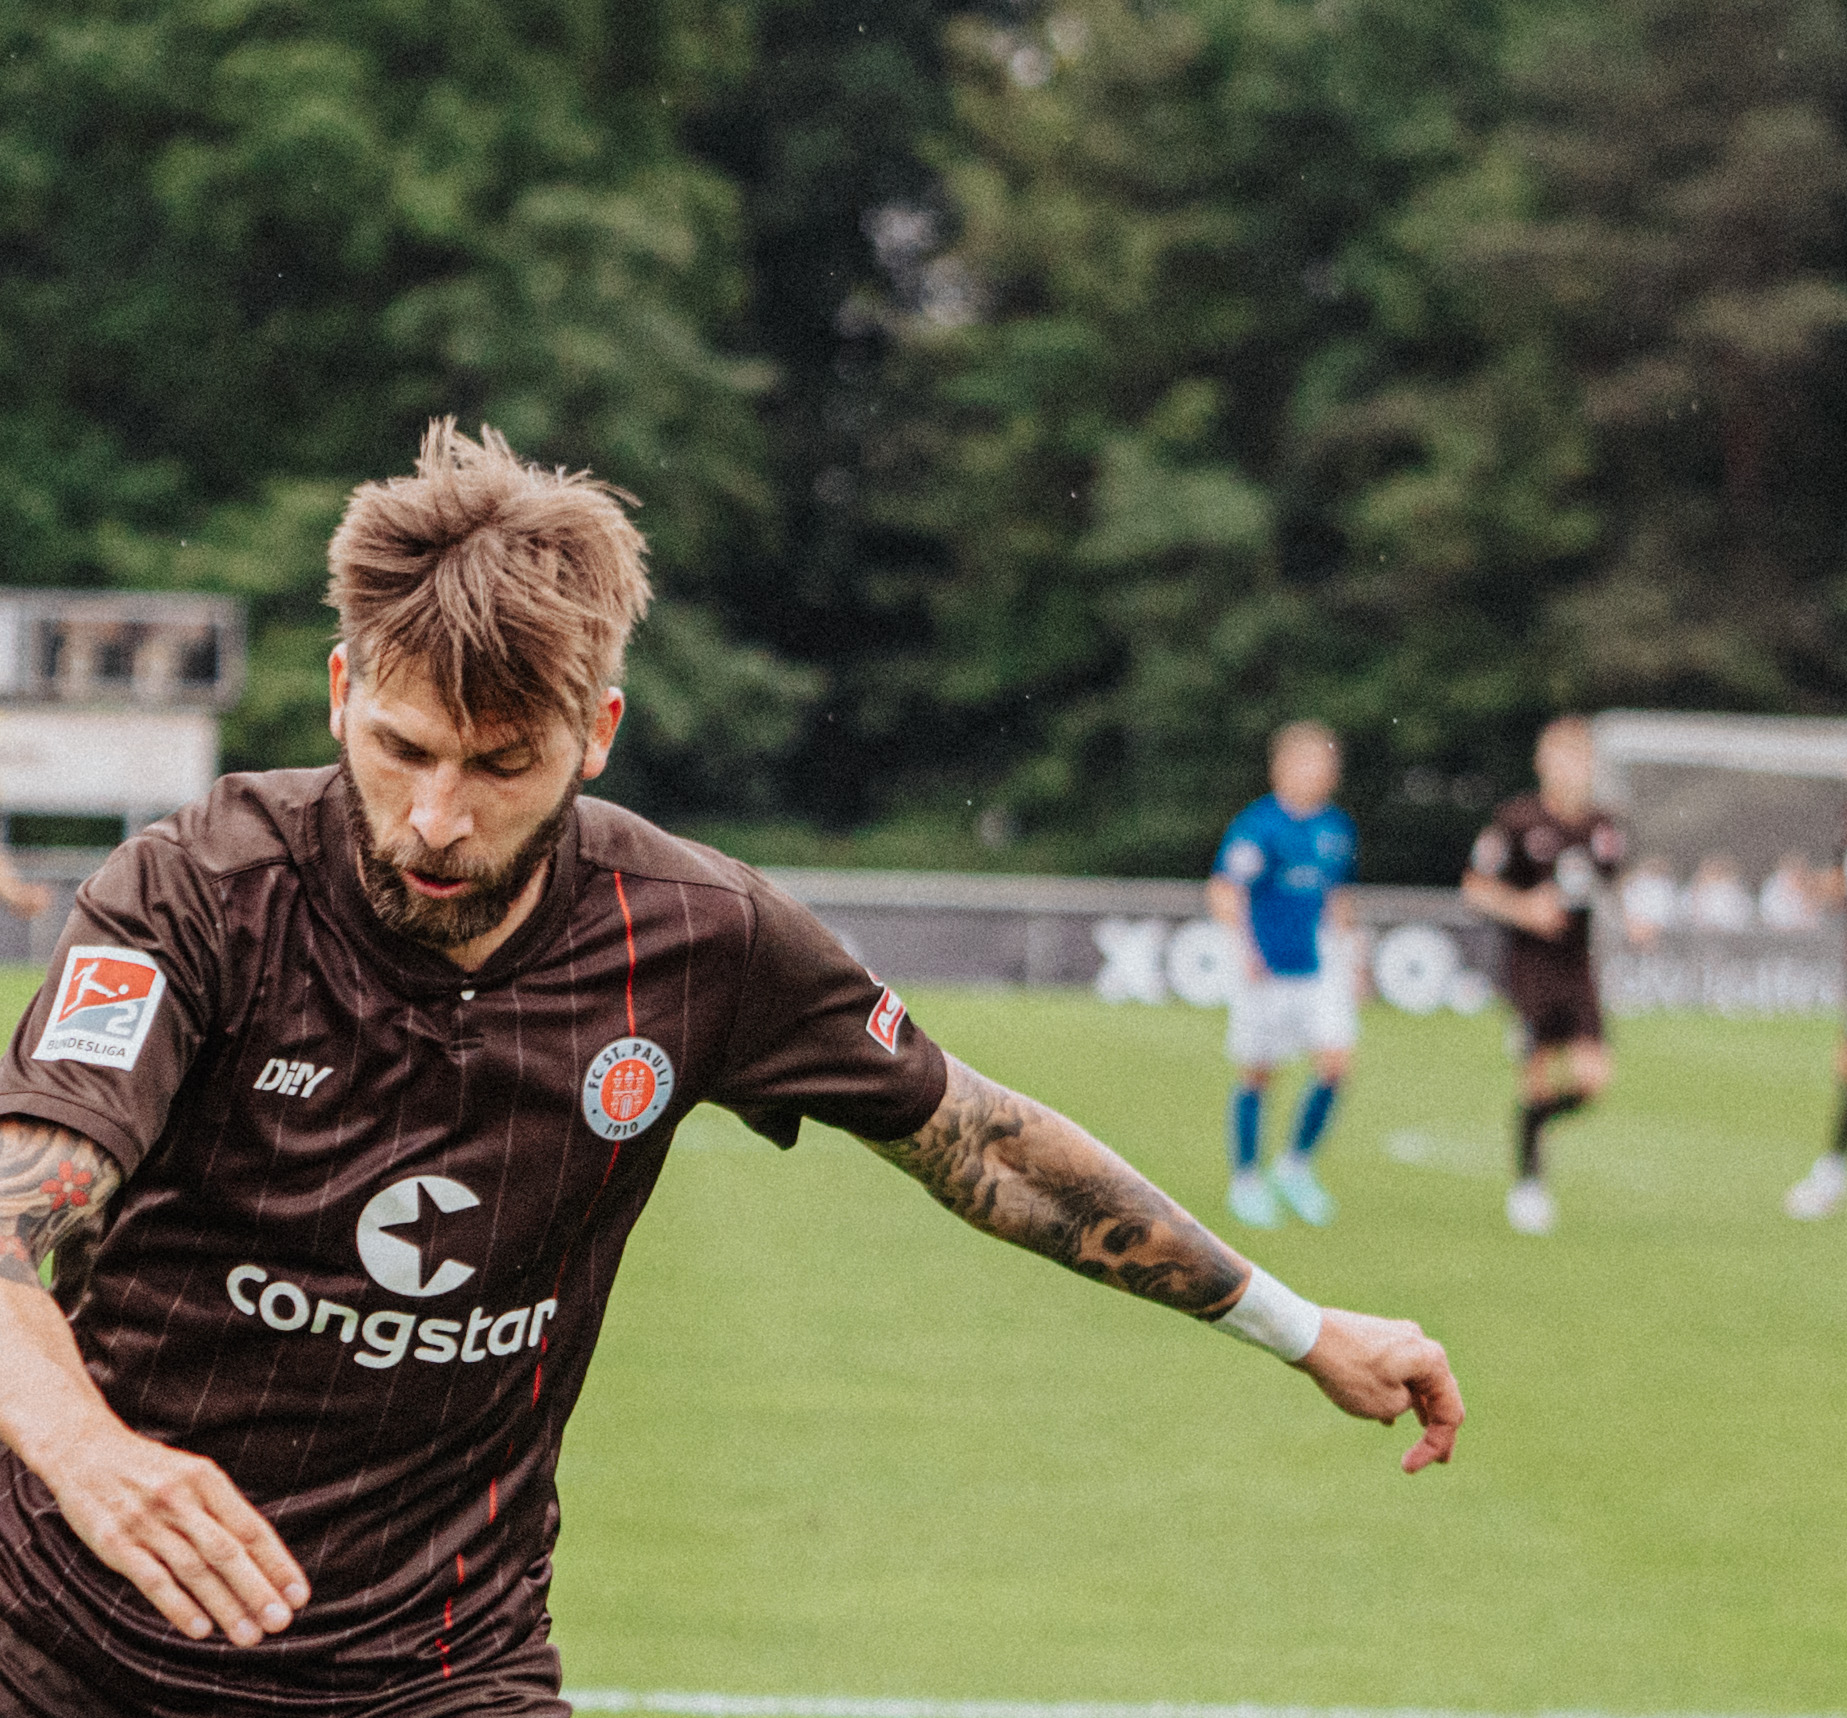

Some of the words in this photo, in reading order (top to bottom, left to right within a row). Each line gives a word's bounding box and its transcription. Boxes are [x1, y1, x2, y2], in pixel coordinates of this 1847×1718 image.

[1092, 917, 1493, 1017] xoo.
[105, 1003, 139, 1037] 2
[46, 1037, 126, 1058] BUNDESLIGA
[588, 1069, 603, 1090] FC
[603, 1046, 626, 1066] ST.
[632, 1043, 669, 1087] PAULI
[605, 1121, 639, 1137] 1910
[226, 1264, 557, 1369] congstar
